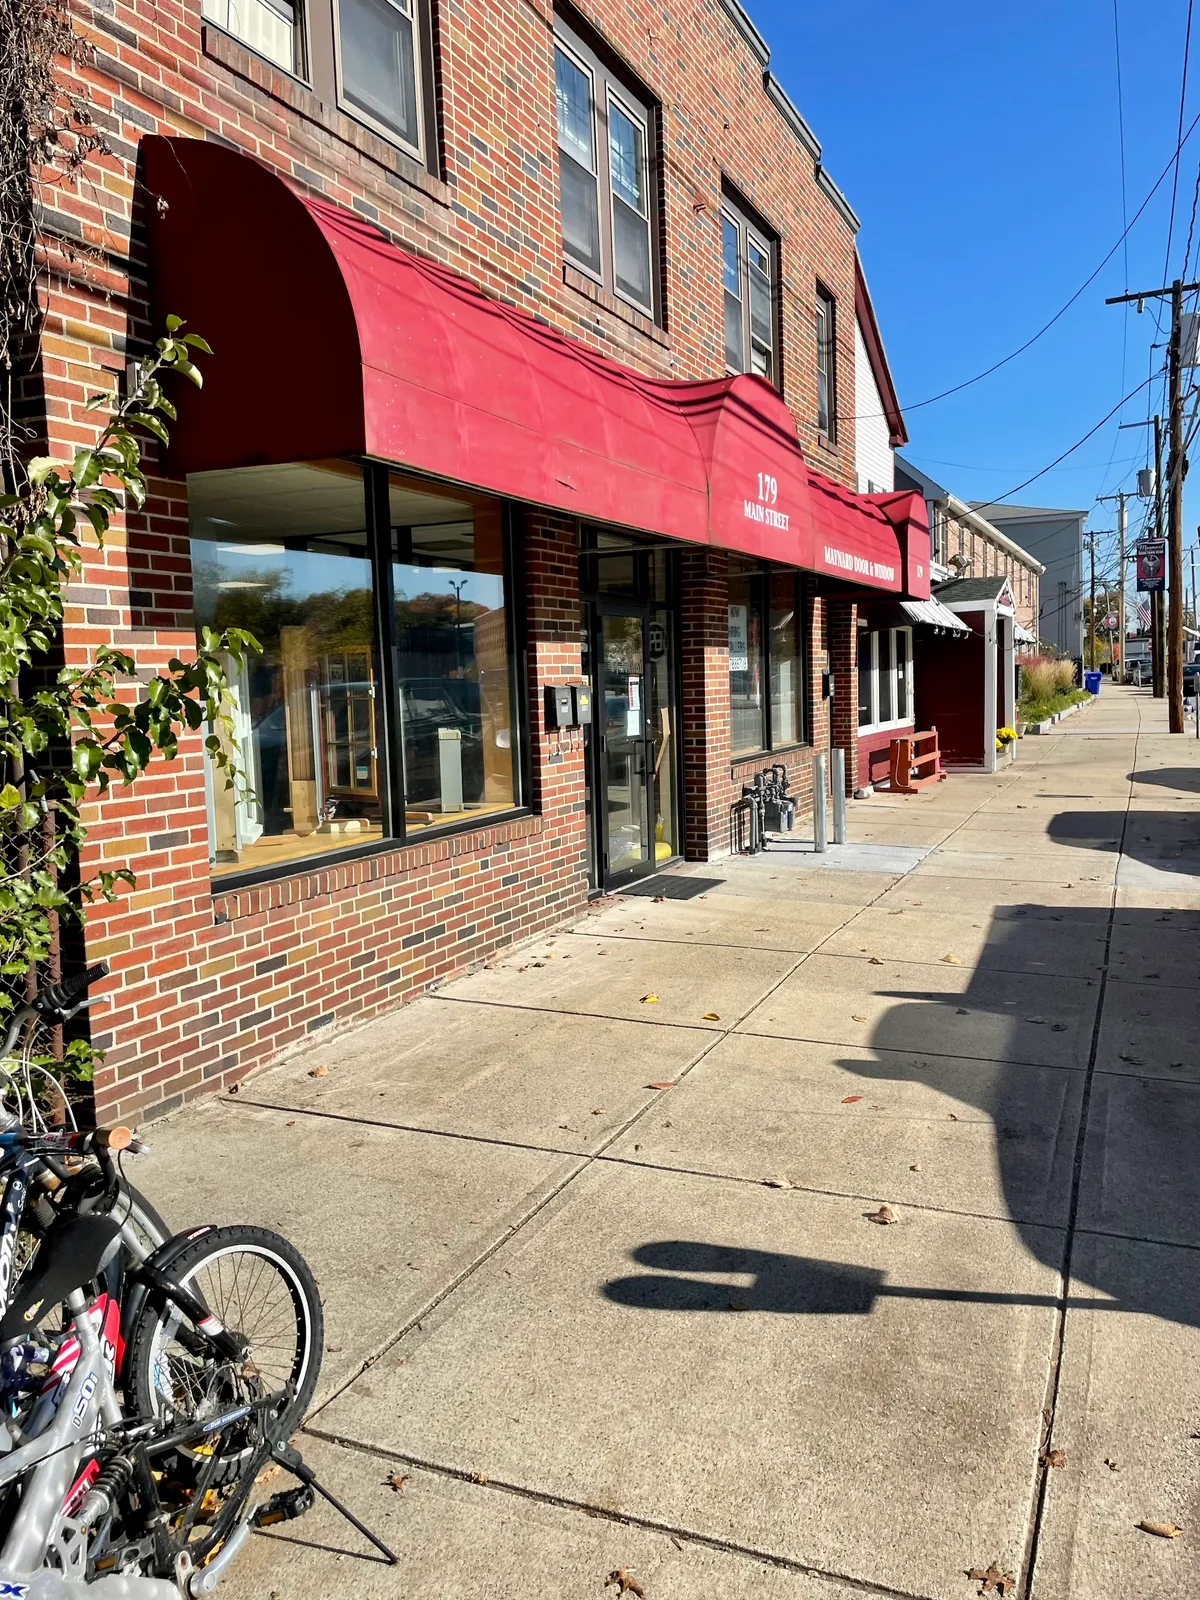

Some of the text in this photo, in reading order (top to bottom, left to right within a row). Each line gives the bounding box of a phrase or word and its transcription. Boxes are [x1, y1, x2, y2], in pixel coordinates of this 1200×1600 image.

[757, 472, 778, 504] 179
[743, 499, 790, 531] MAIN STREET
[824, 545, 895, 582] MAYNARD DOOR & WINDOW
